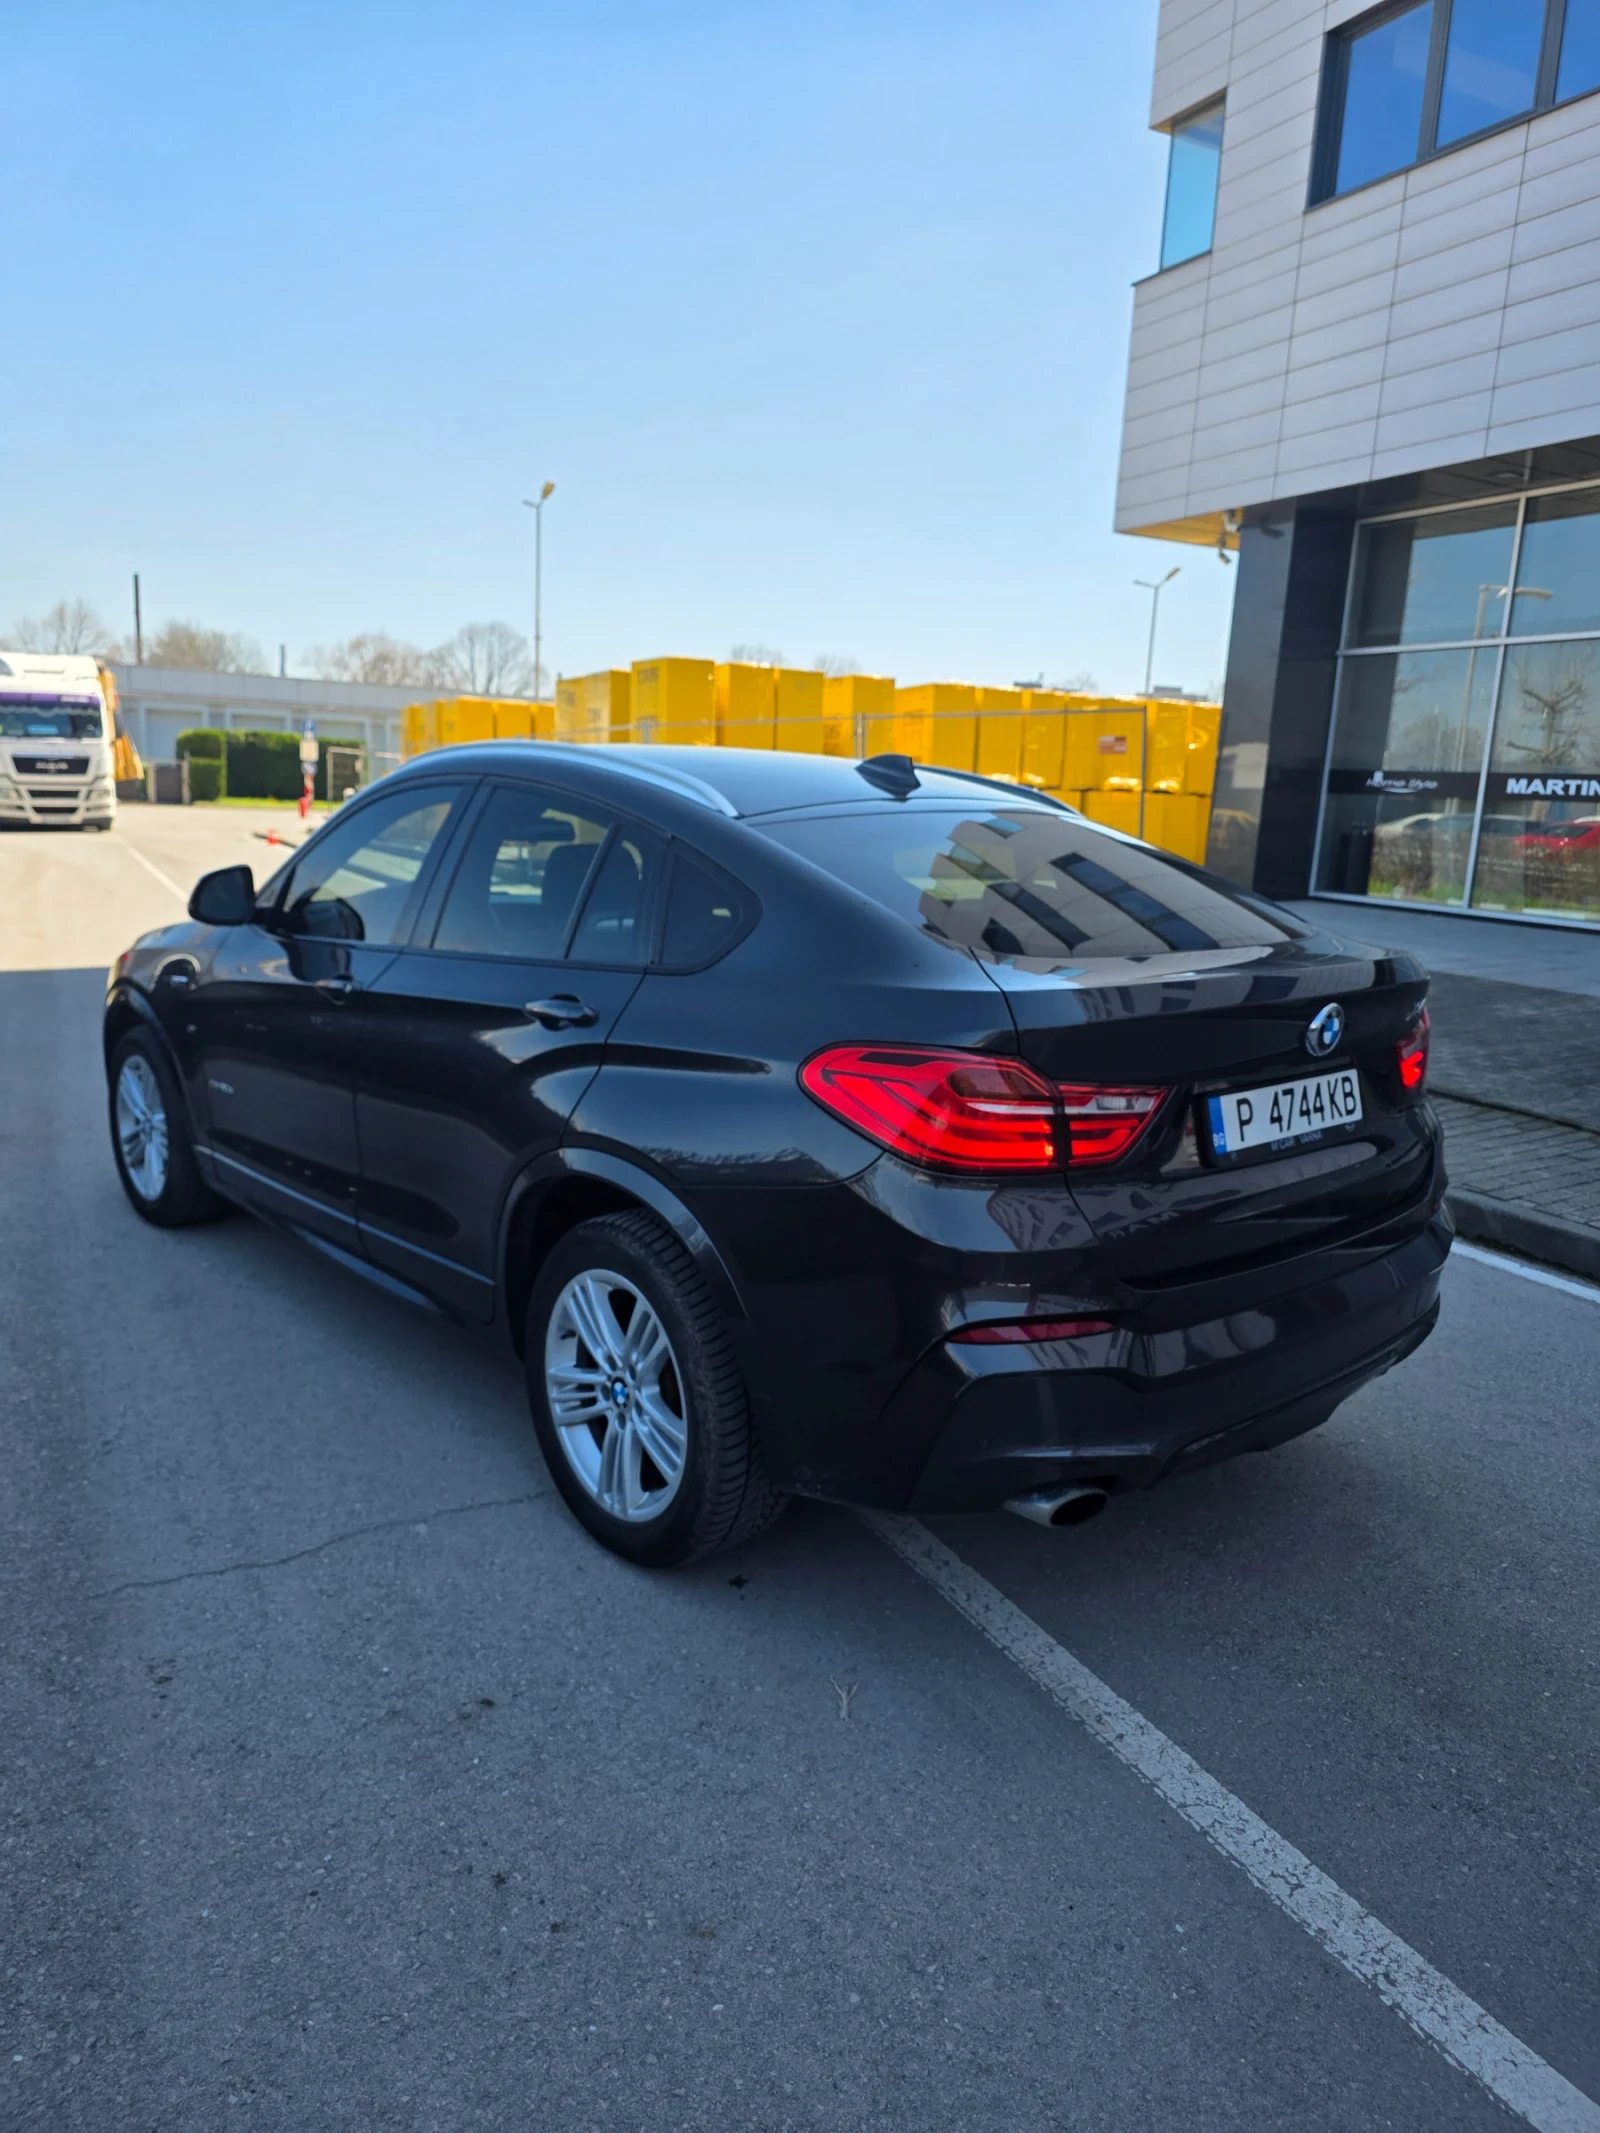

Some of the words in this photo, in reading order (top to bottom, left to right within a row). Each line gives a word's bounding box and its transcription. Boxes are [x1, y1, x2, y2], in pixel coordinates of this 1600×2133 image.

[1506, 778, 1600, 796] MARTIN
[1236, 1097, 1254, 1142] P
[1270, 1076, 1357, 1132] 4744KB
[1212, 1132, 1226, 1146] BG
